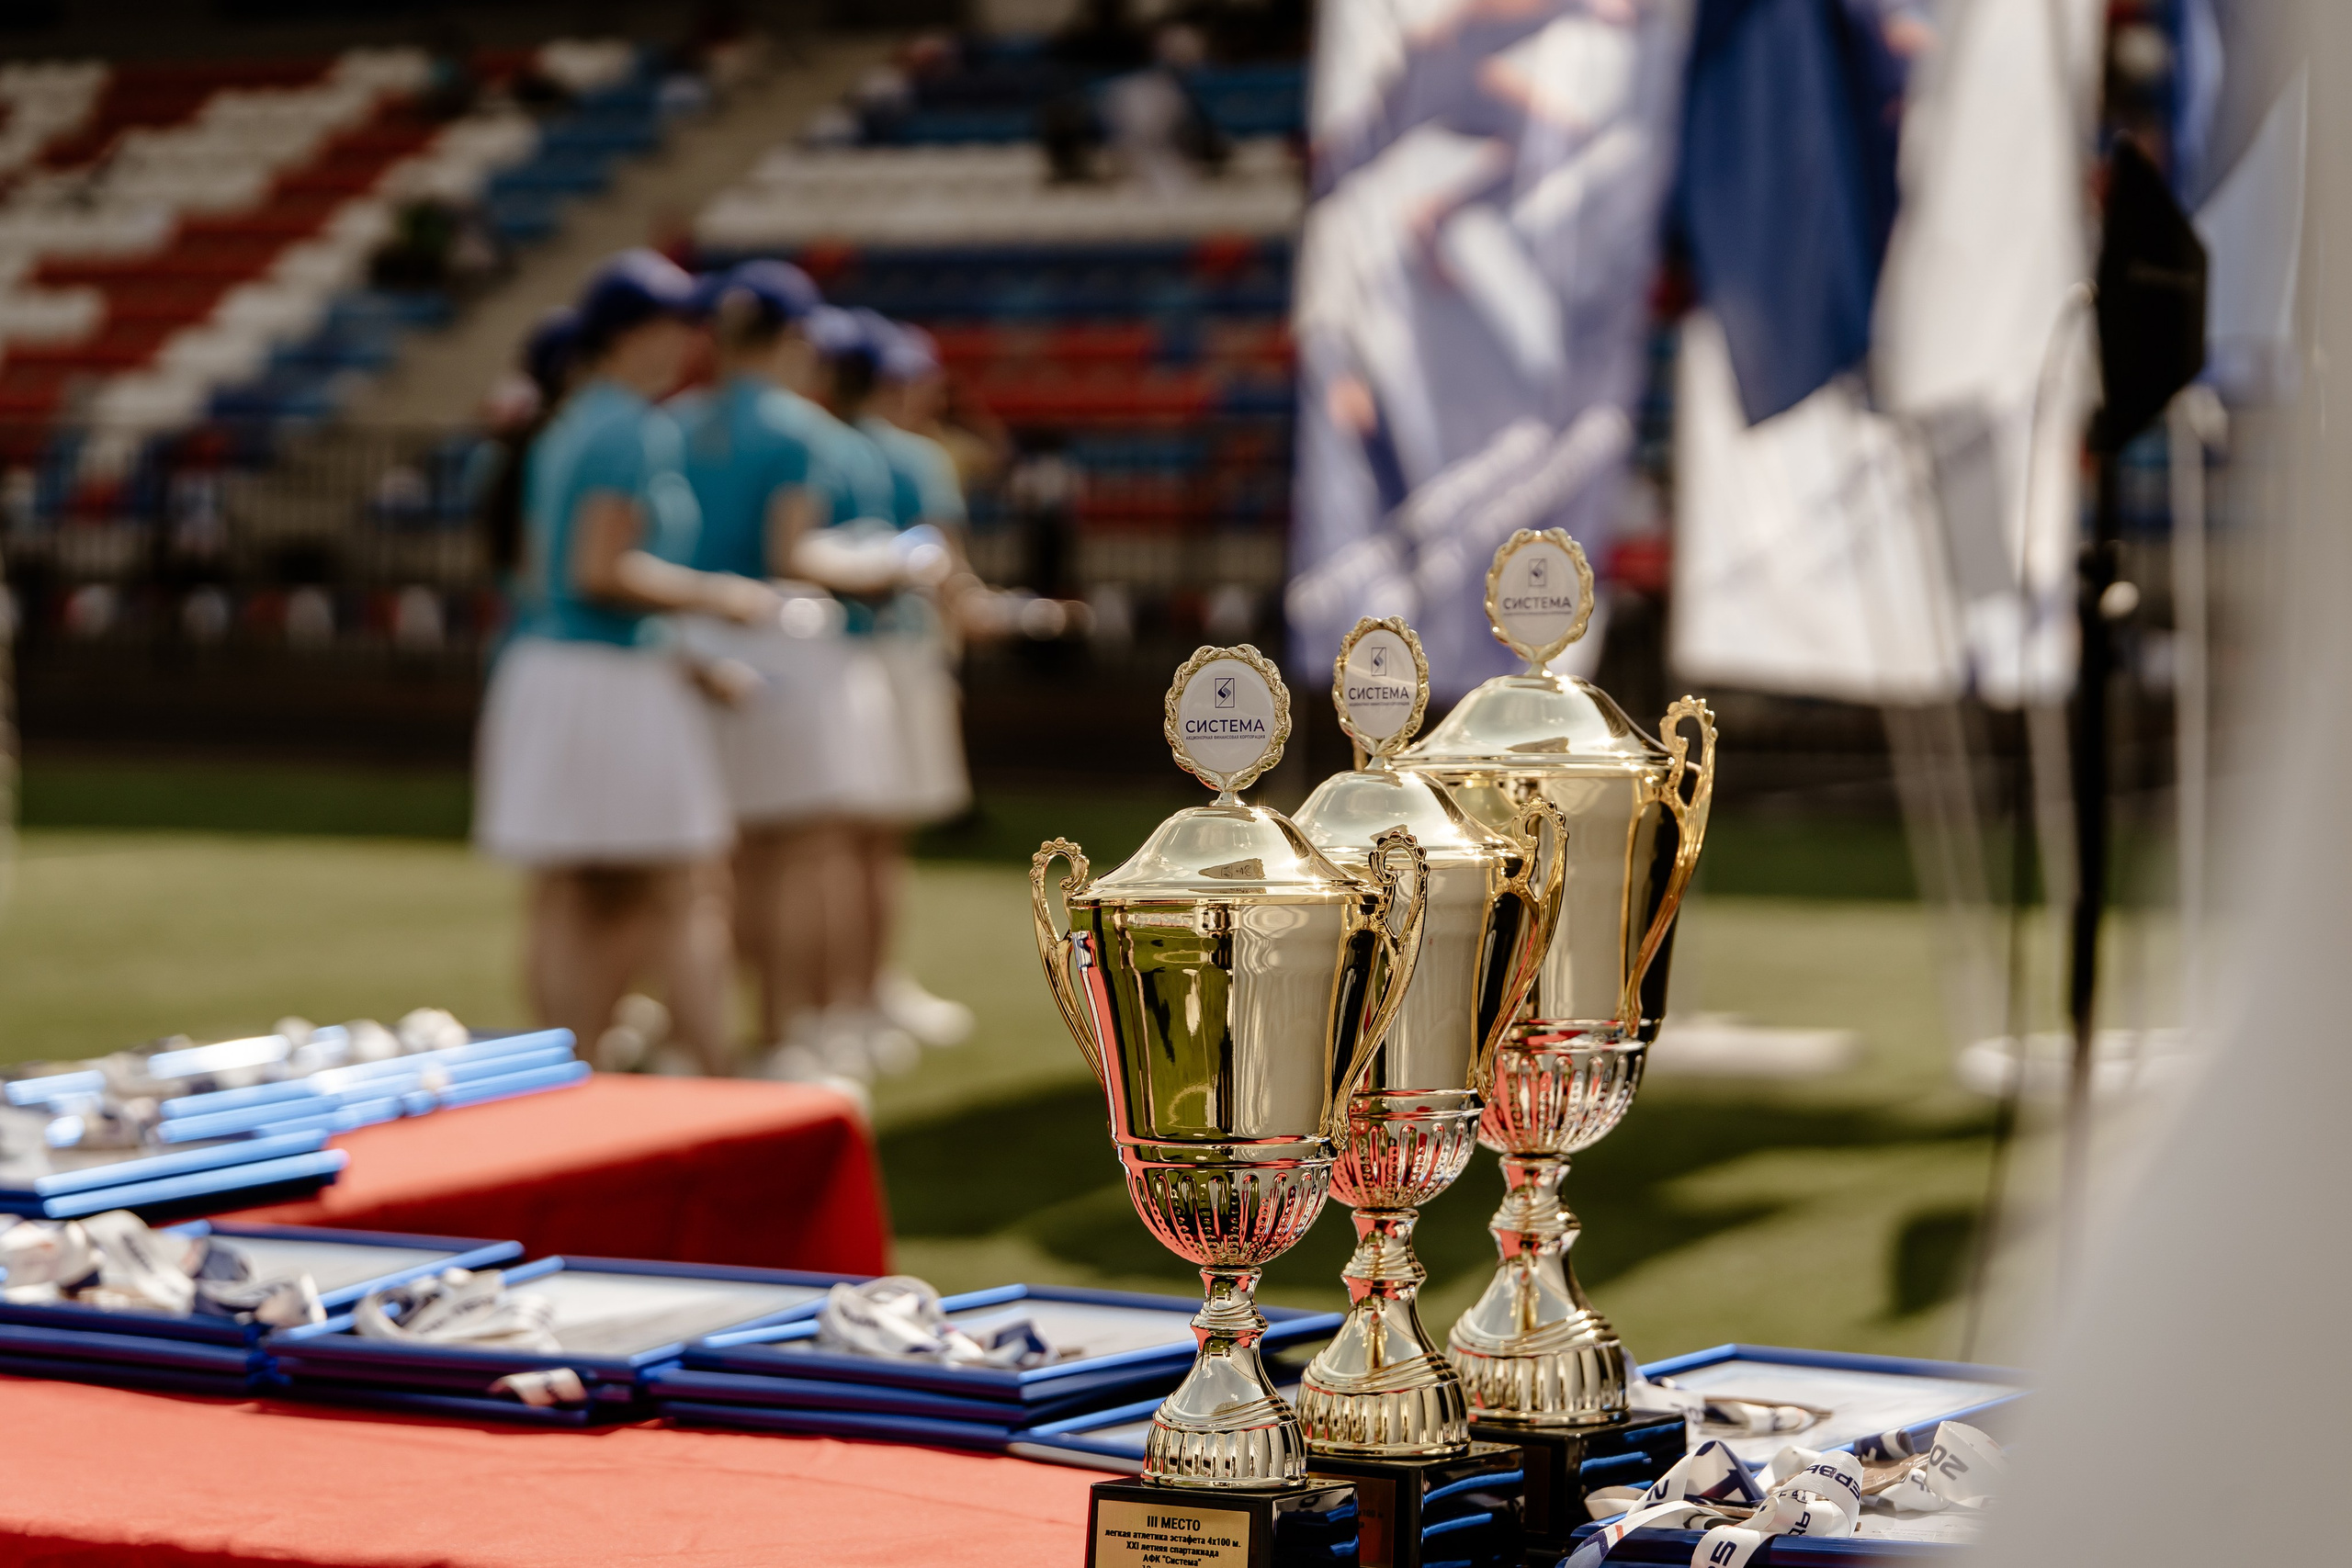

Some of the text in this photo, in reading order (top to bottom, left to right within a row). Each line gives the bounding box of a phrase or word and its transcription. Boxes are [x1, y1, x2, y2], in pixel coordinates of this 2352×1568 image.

[1502, 596, 1572, 610] СИСТЕМА
[1348, 686, 1409, 700] СИСТЕМА
[1185, 718, 1265, 733] СИСТЕМА
[1147, 1515, 1201, 1532] III МЕСТО
[1104, 1529, 1131, 1538] легкая
[1133, 1531, 1169, 1542] атлетика
[1170, 1534, 1205, 1546] эстафета
[1232, 1540, 1241, 1548] м.
[1126, 1540, 1219, 1559] XXI летняя спартакиада
[1142, 1553, 1202, 1567] АФК "Система"
